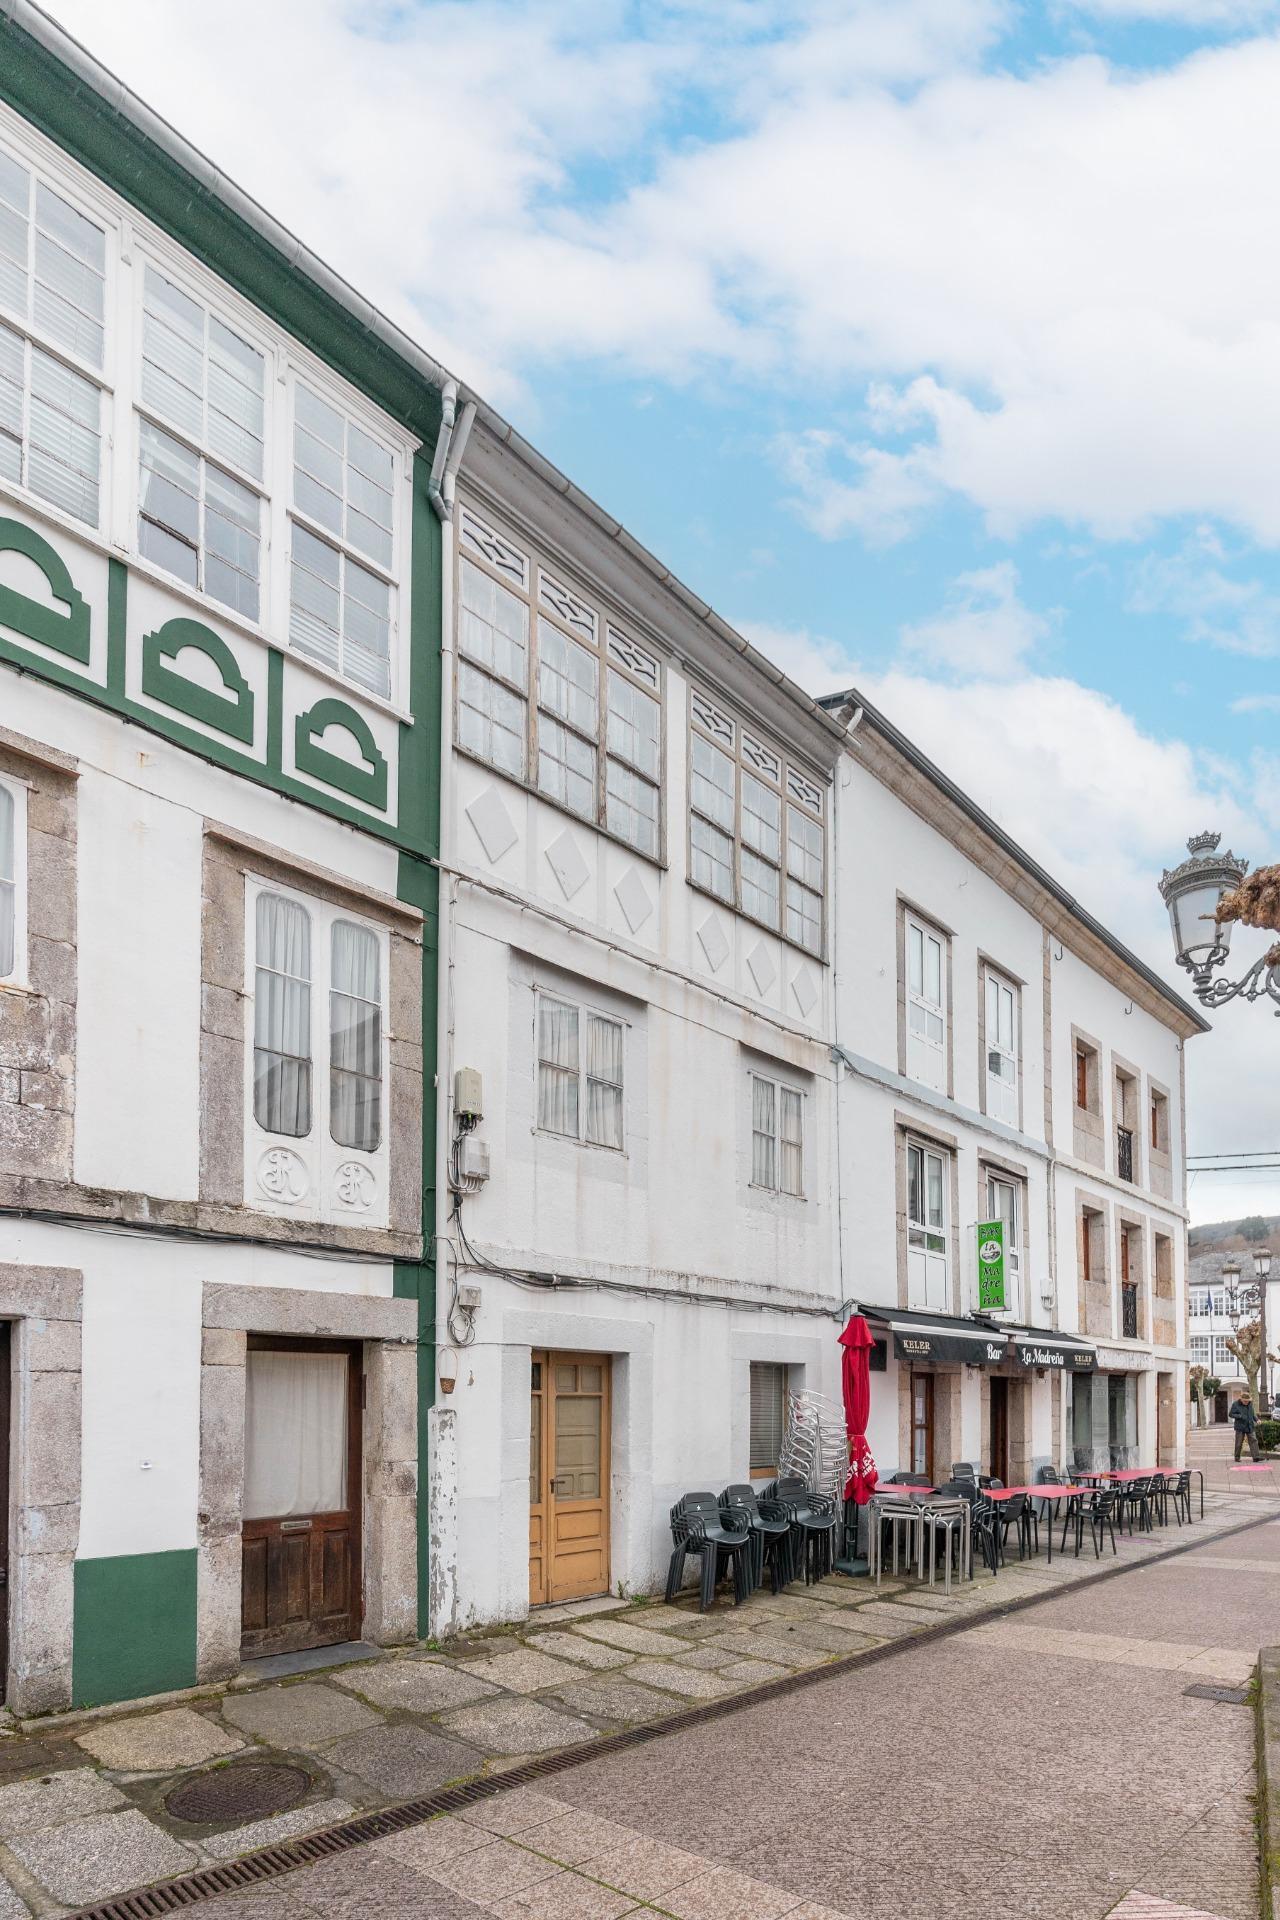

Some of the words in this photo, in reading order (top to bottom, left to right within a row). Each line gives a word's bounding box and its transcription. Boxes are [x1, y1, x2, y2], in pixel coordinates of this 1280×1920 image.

[903, 1339, 931, 1350] KELER
[986, 1343, 1003, 1360] Bar
[1022, 1347, 1032, 1366] La
[1032, 1348, 1065, 1365] Madreña
[1074, 1354, 1093, 1363] KELER
